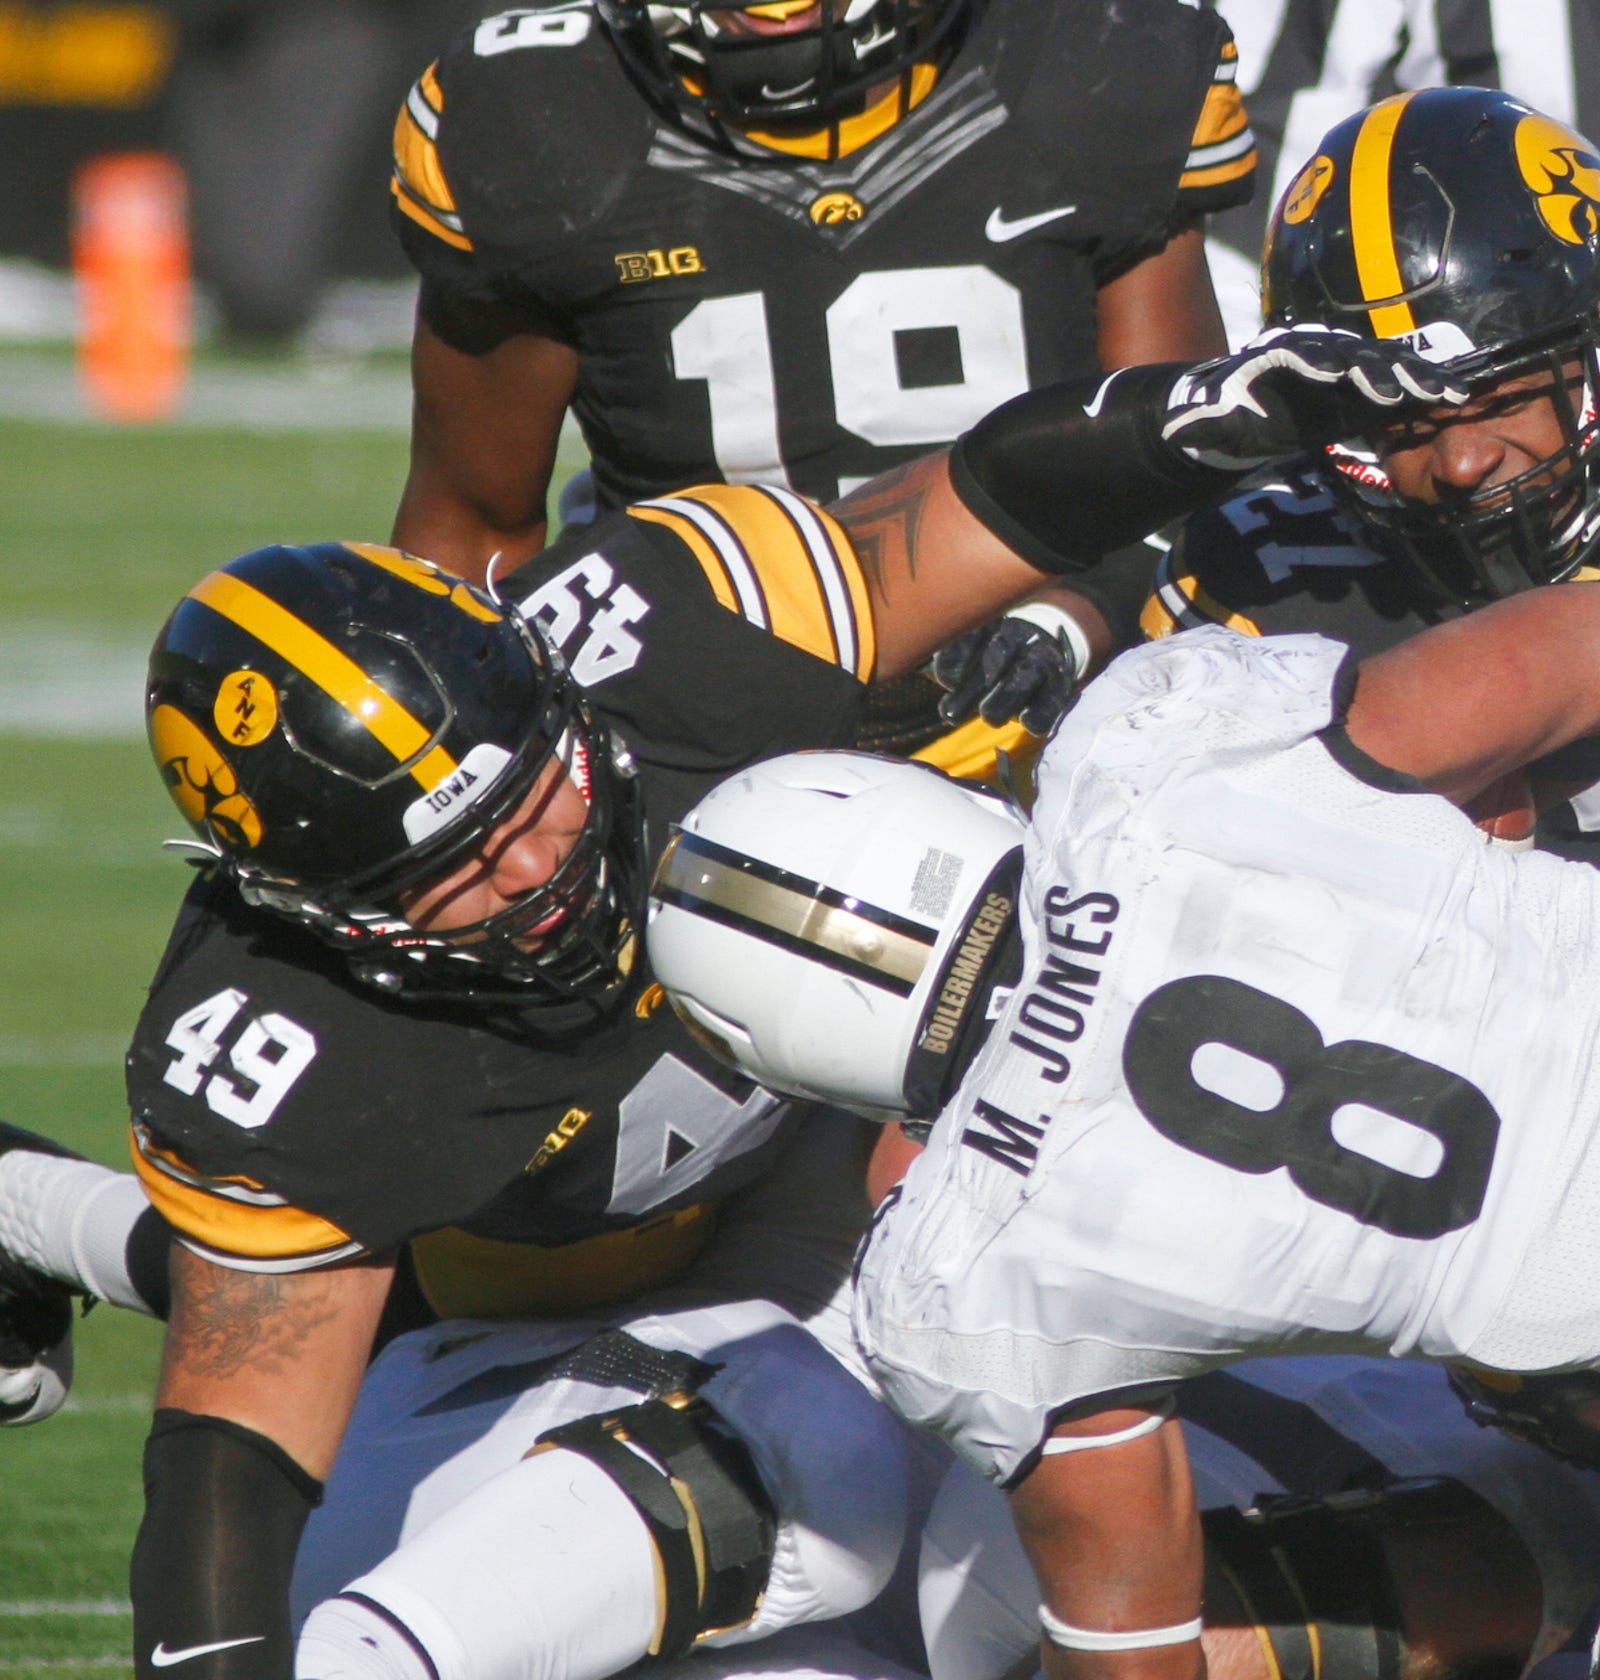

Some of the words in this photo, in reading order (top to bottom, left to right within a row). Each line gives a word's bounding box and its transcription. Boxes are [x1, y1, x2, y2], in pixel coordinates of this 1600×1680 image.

[670, 264, 1031, 502] 19
[518, 552, 651, 688] 49
[232, 677, 256, 738] ANF
[425, 769, 478, 814] IOWA
[921, 892, 1010, 1055] BOILERMAKERS
[961, 1097, 1051, 1177] M.
[1009, 886, 1120, 1084] JONES
[163, 987, 317, 1129] 49
[1122, 974, 1501, 1241] 8
